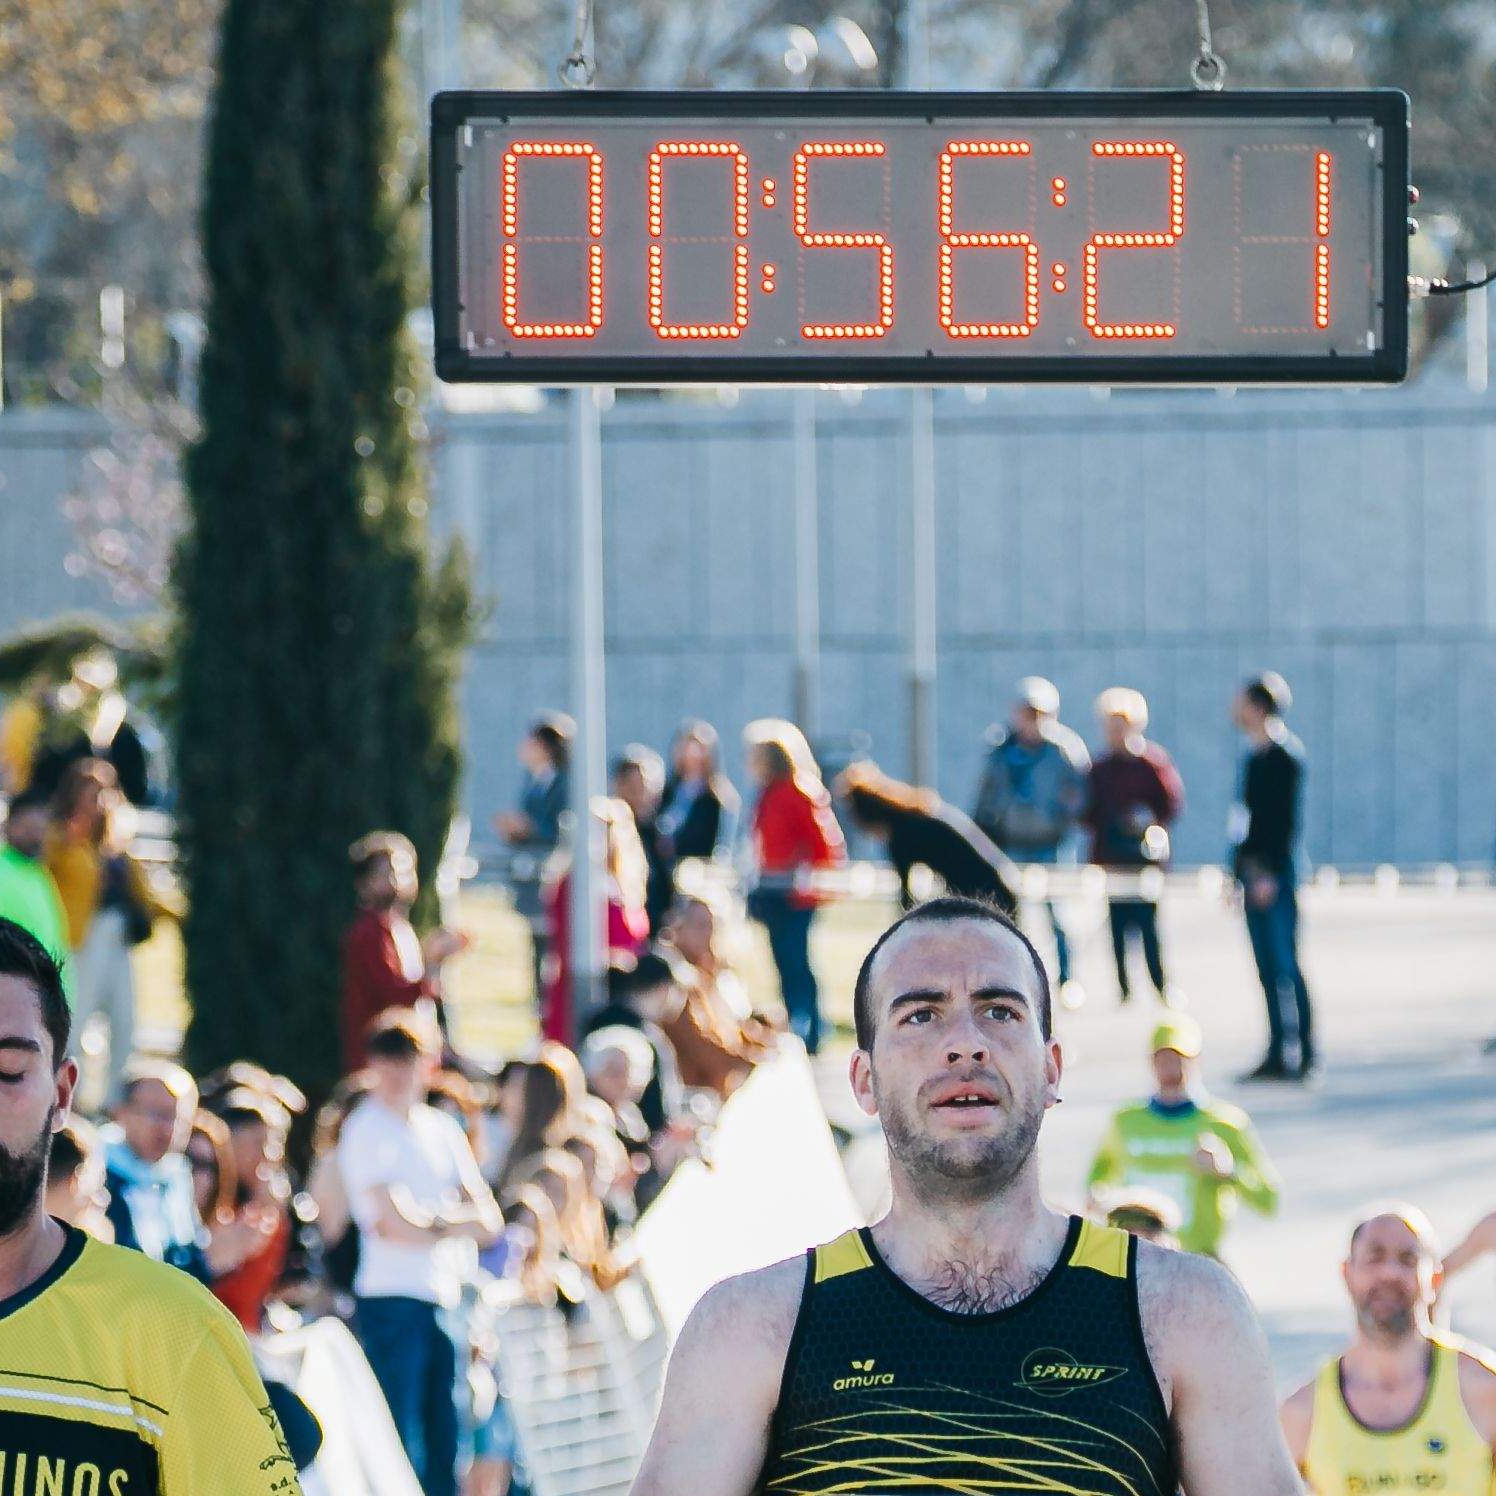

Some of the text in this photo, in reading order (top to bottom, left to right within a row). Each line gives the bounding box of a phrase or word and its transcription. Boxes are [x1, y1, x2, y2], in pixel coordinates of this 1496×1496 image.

[502, 140, 1332, 339] 00:56:21
[1031, 1364, 1106, 1380] SPRINT
[833, 1373, 895, 1391] amura
